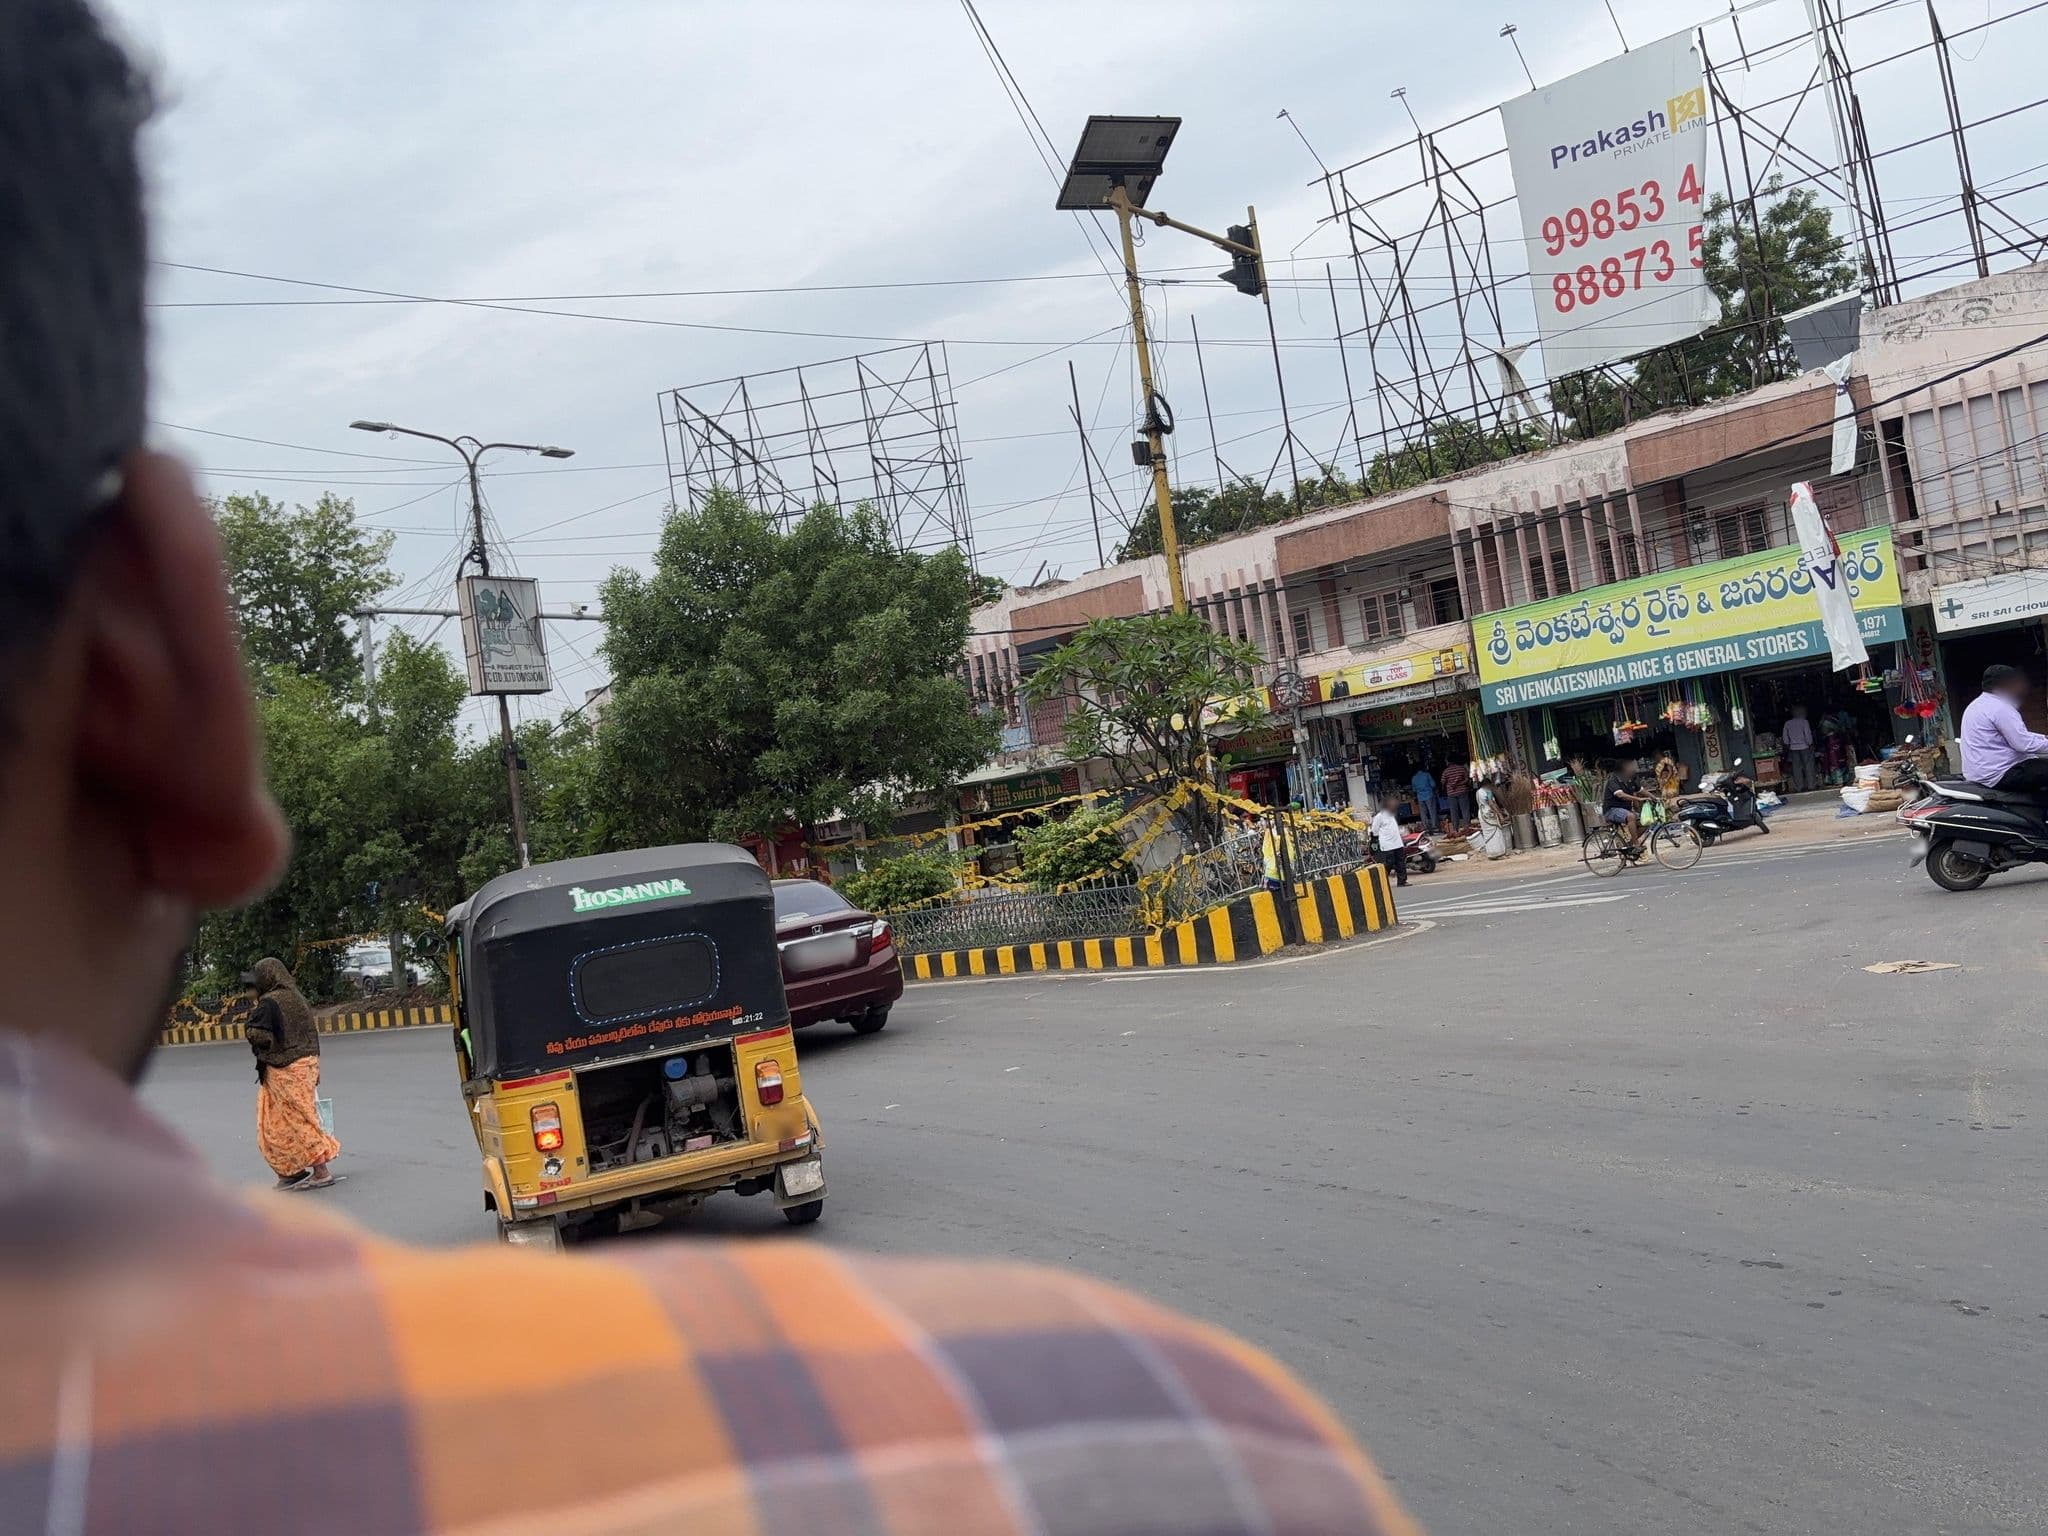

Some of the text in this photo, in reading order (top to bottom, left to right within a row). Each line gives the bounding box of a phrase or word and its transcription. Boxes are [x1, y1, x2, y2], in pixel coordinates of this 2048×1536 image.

[1550, 110, 1666, 169] Prakash
[1613, 131, 1671, 160] PRIVATE
[1541, 163, 1705, 257] 99853 4
[1551, 239, 1675, 314] 88873
[1487, 620, 1512, 666] శ్రీ
[1515, 597, 1641, 651] వెంకటేశ్వర
[1643, 584, 1690, 637] రైస్
[1697, 591, 1714, 614] &
[1971, 607, 1990, 620] SRI
[1993, 605, 2012, 617] SAI
[1495, 686, 1517, 706] SRI
[1519, 663, 1627, 702] VENKATESWARA
[1629, 657, 1661, 682] RICE
[1663, 655, 1674, 675] &
[1676, 641, 1746, 673] GENERAL
[1746, 630, 1809, 660] STORES
[1862, 614, 1887, 631] 1971
[1012, 783, 1063, 802] SWEET INDIA
[568, 878, 690, 911] HOSANNA
